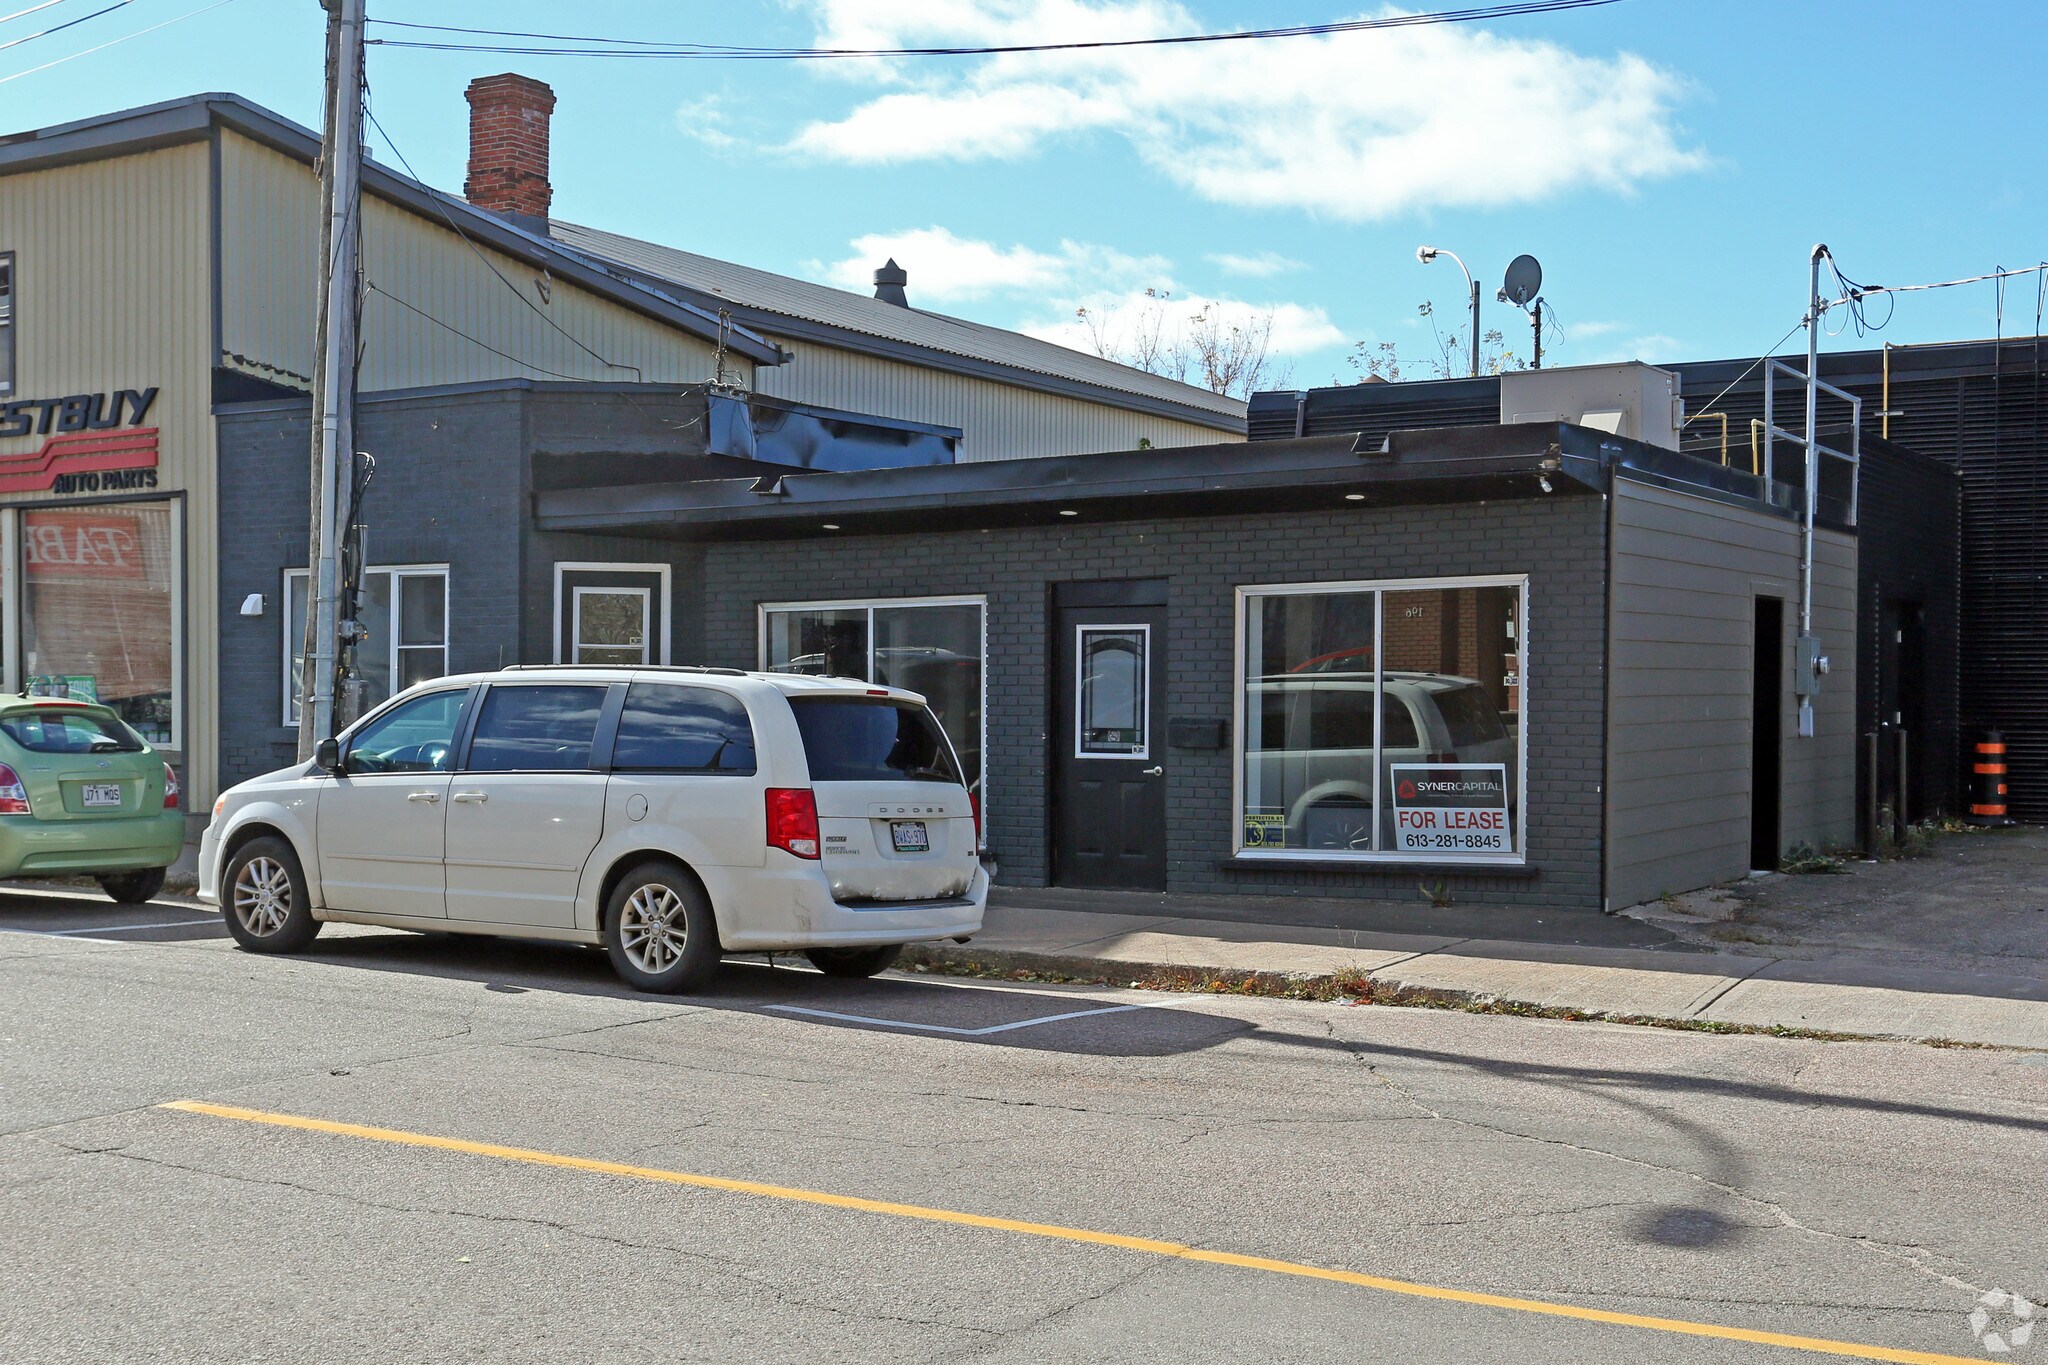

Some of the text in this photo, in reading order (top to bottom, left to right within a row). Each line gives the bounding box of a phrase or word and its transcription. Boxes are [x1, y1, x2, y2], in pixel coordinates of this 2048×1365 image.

[0, 387, 159, 437] STBUY
[54, 468, 158, 494] AUTO PARTS
[1417, 782, 1502, 791] SYNERCAPITAL
[1399, 811, 1504, 830] FOR LEASE
[1406, 834, 1501, 848] 613-281-8845
